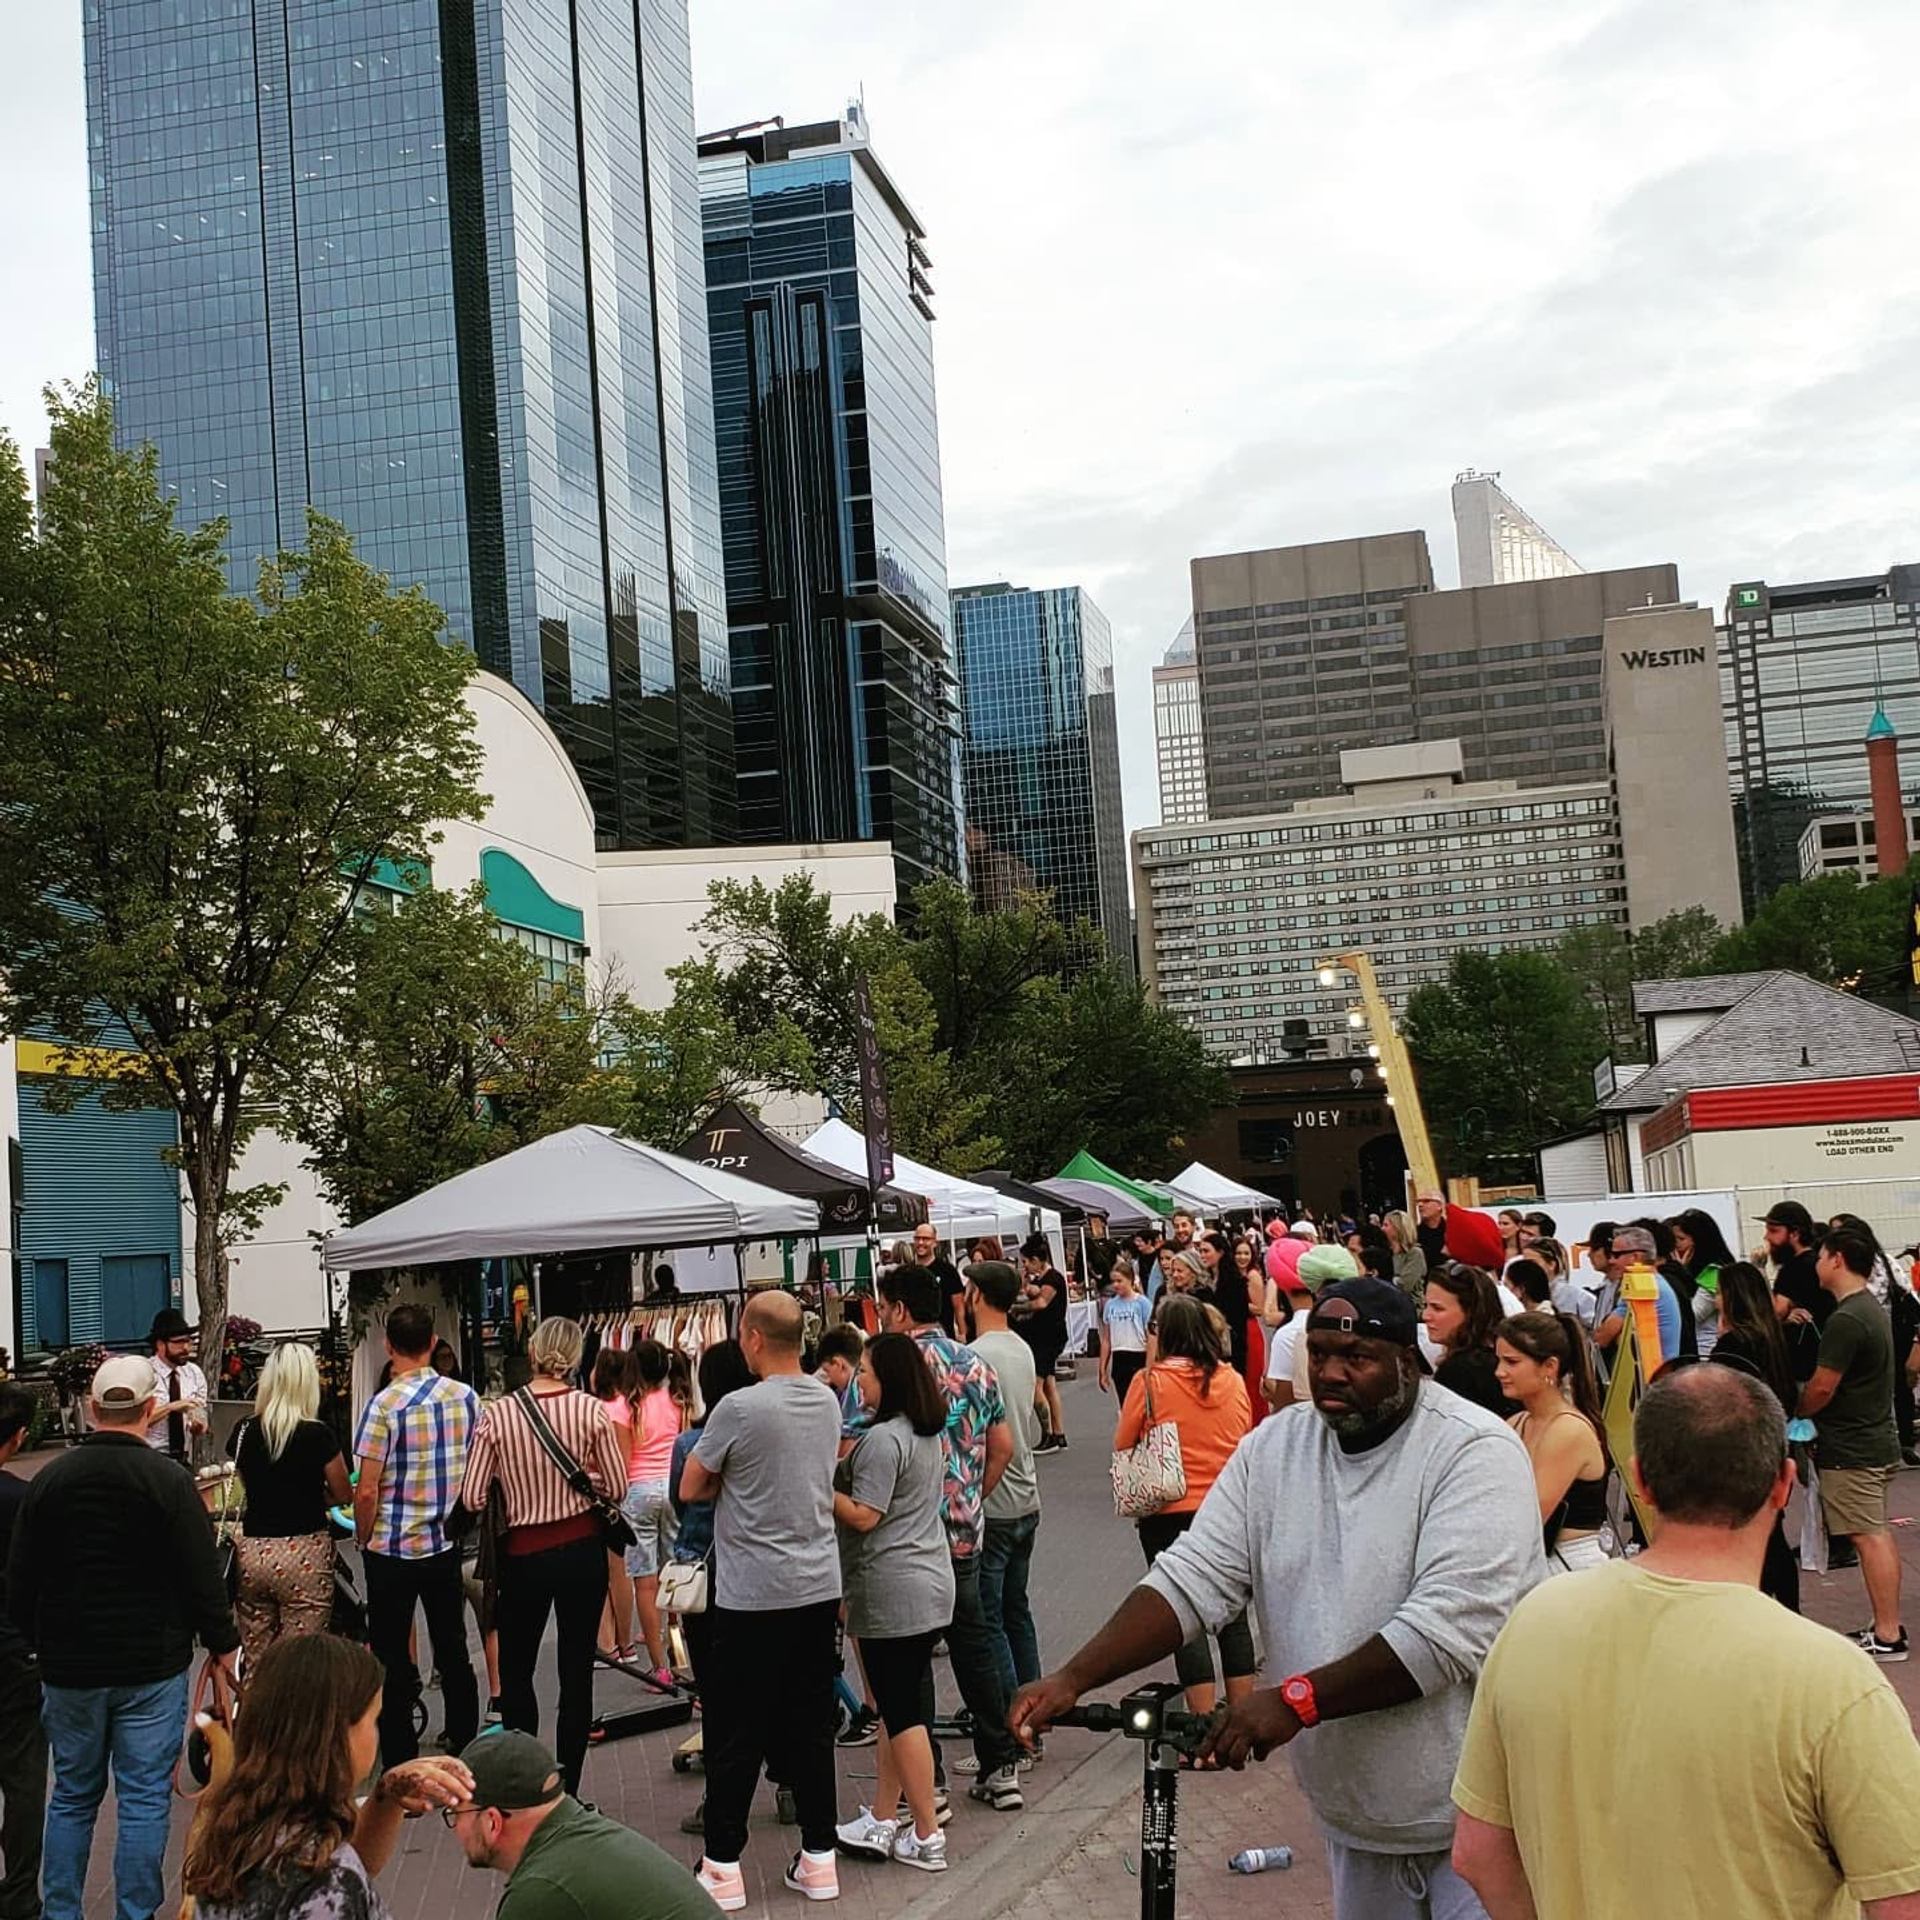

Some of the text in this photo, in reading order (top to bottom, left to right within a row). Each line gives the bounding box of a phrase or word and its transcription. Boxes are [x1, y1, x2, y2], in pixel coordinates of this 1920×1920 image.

[1738, 590, 1758, 603] TD
[1621, 646, 1705, 670] WESTIN
[1293, 1109, 1341, 1129] JOEY
[1826, 1145, 1894, 1156] LOAD OTHER END
[696, 1156, 749, 1168] OPI
